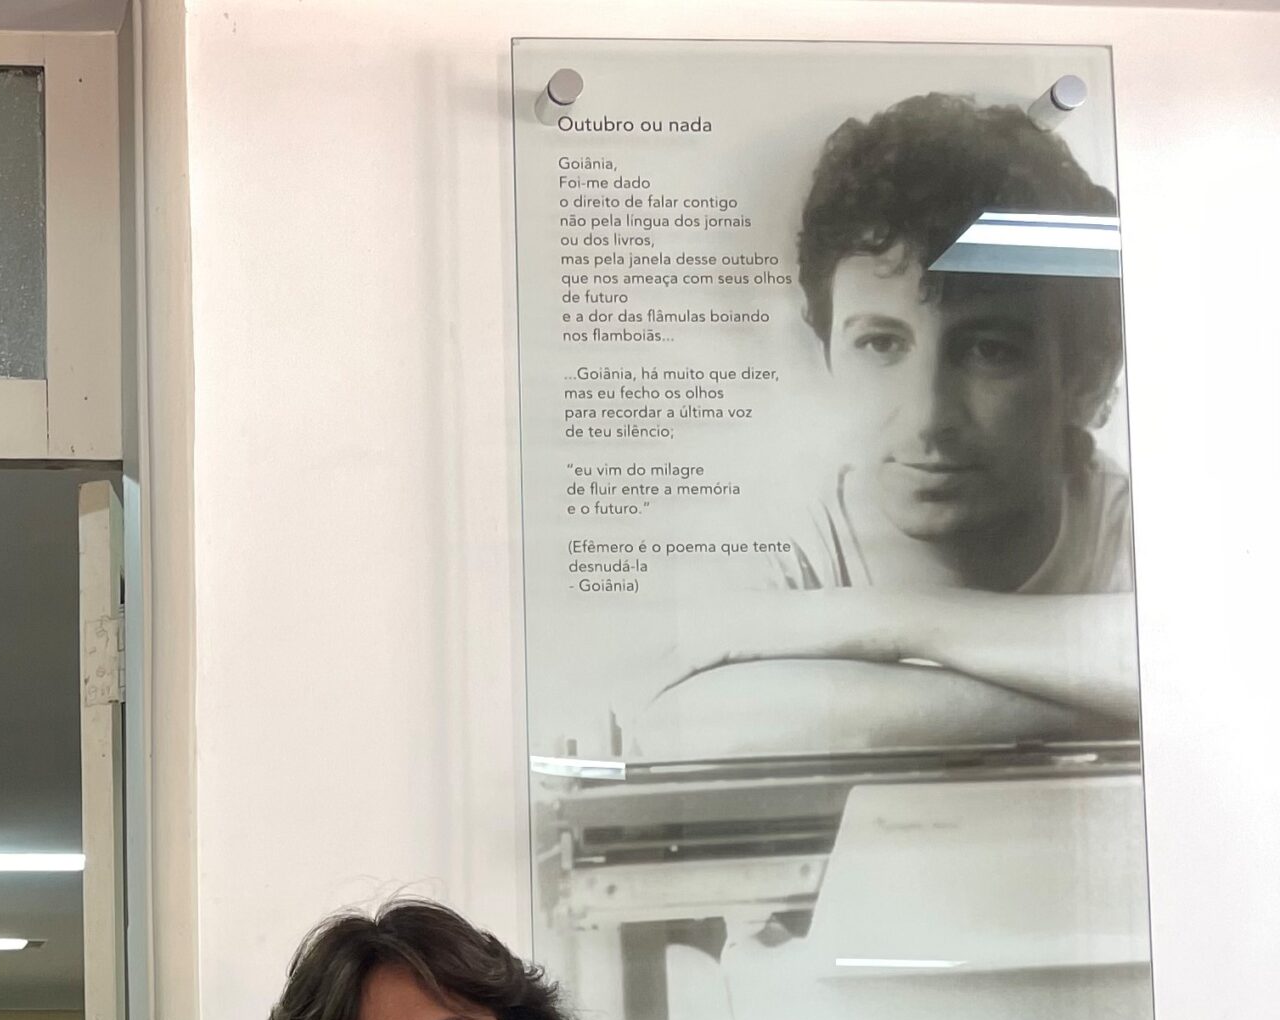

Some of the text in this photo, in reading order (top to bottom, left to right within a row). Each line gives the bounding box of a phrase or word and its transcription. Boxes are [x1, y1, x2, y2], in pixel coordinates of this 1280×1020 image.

[557, 115, 712, 133] Outubro ou nada
[558, 156, 617, 172] Goiânia,
[559, 175, 651, 190] Foi-me dado
[559, 212, 752, 231] não pela língua dos jornais
[560, 251, 779, 269] mas pela janela desse outubro
[561, 270, 793, 289] que nos ameaça com seus olhos
[562, 327, 674, 342] nos flamboiãs...
[564, 366, 779, 384] ...Goiânia, há muito que dizer,
[596, 463, 622, 477] vim
[626, 462, 647, 477] do
[650, 461, 705, 480] milagre
[566, 480, 741, 496] de fluir entre a memória
[568, 558, 648, 573] desnudá-la
